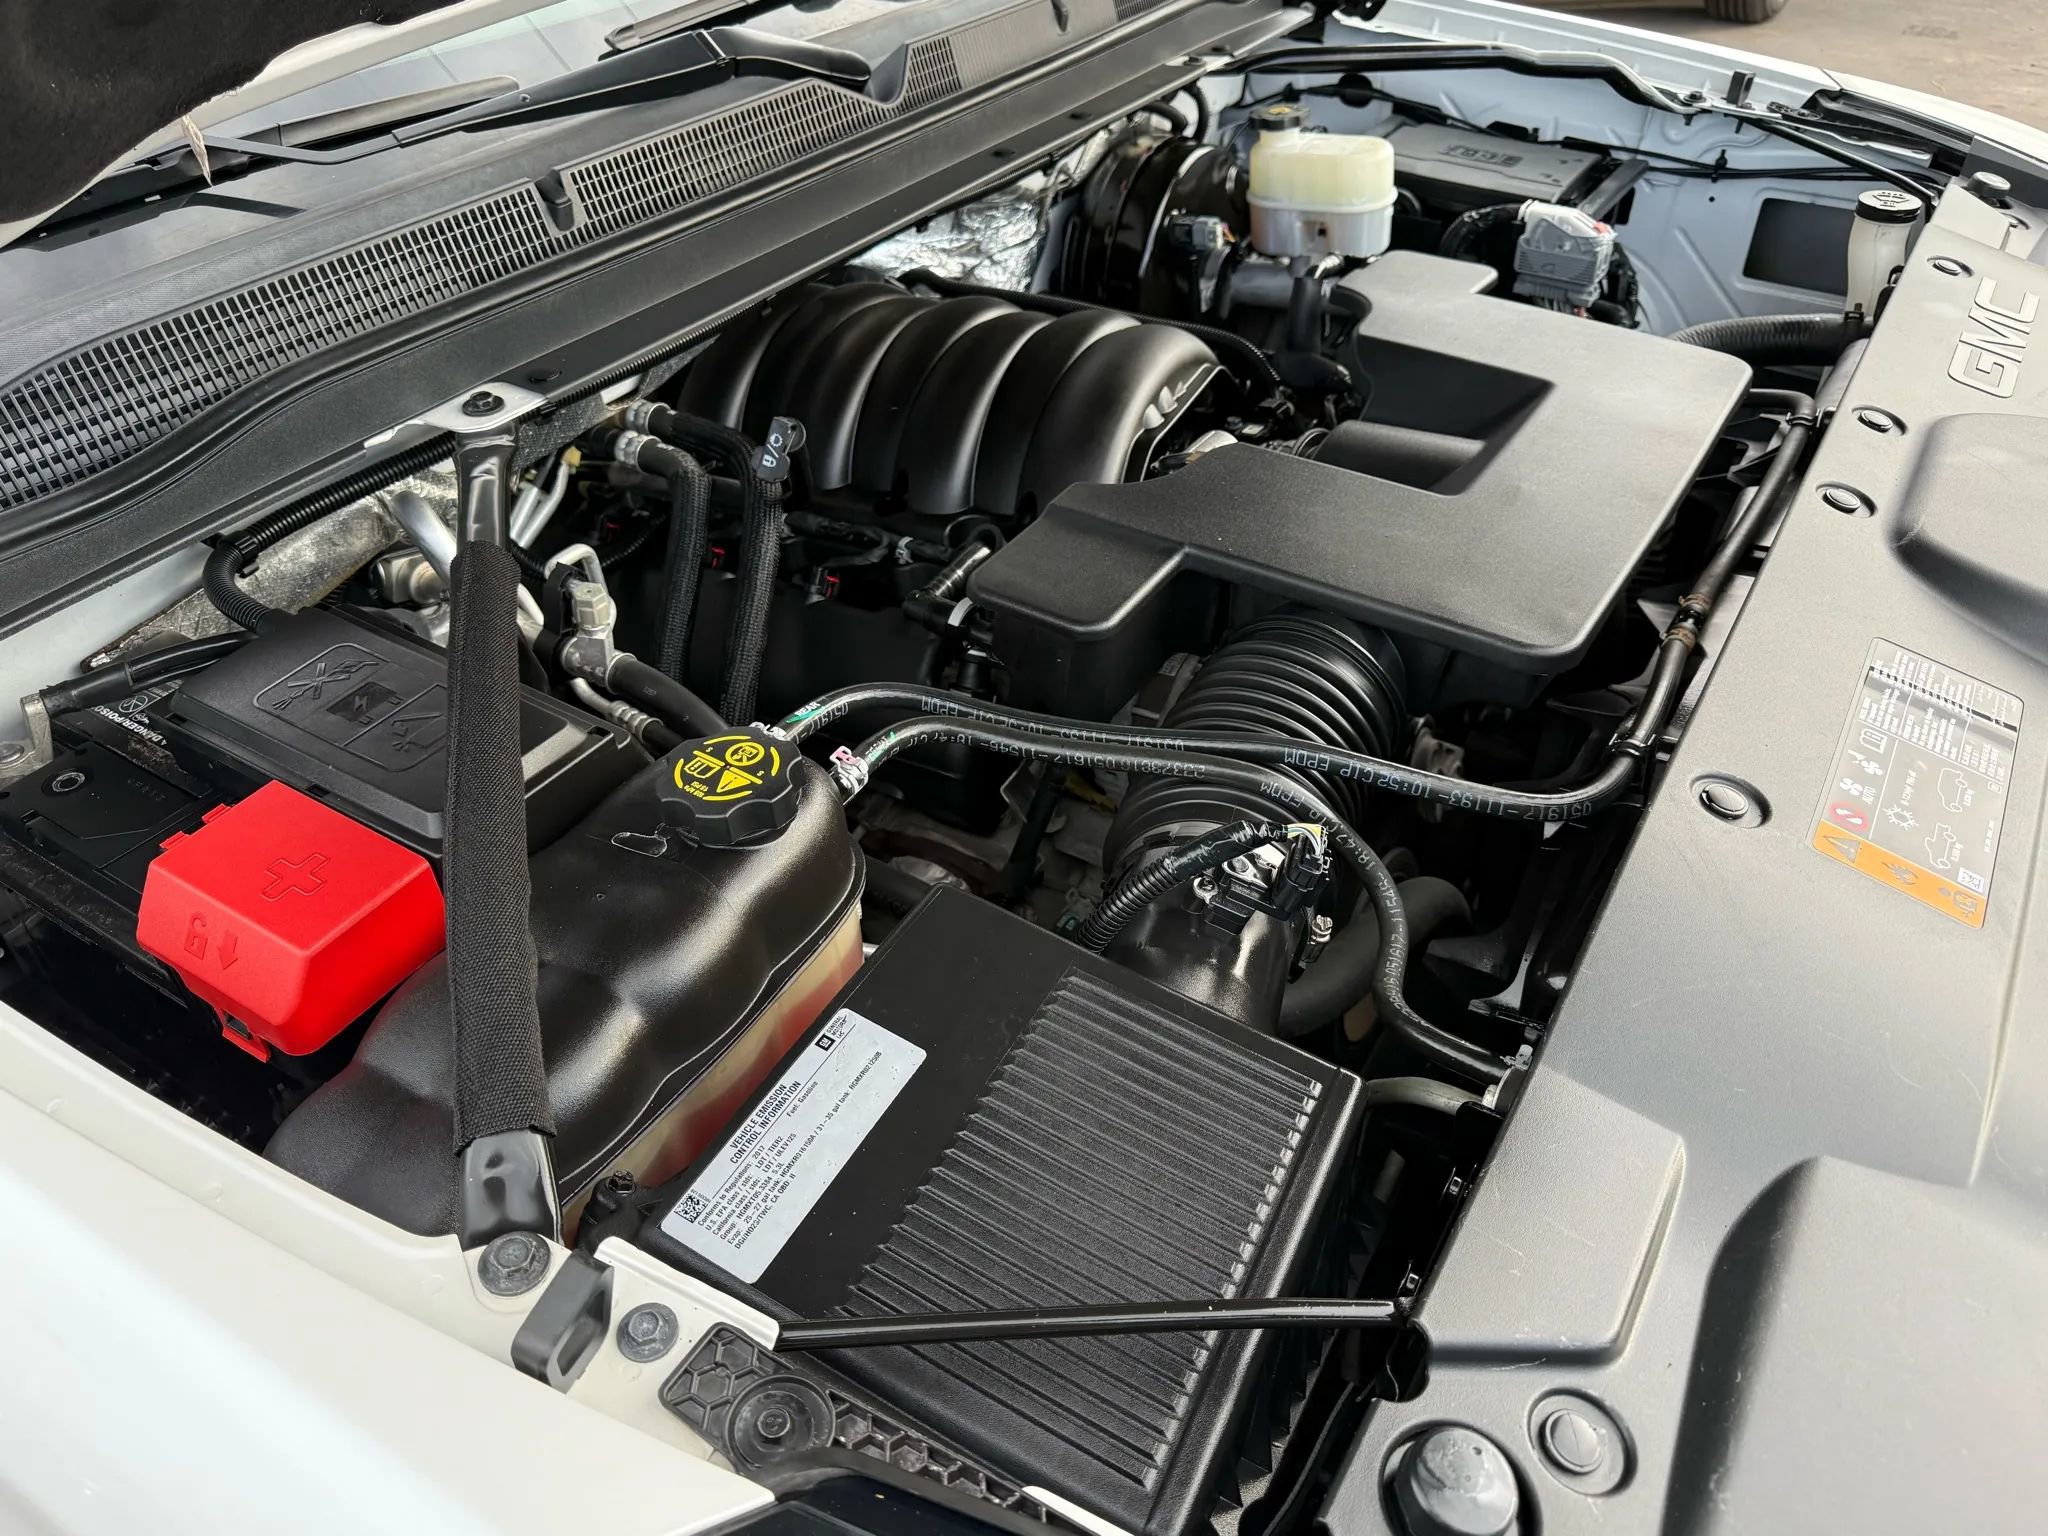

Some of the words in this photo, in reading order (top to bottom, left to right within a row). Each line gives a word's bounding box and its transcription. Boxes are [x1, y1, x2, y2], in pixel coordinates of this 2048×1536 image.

[1947, 276, 2040, 398] GMC
[91, 705, 163, 742] DANGER/POISO
[795, 701, 821, 716] REAR
[921, 696, 958, 717] EPDM
[1284, 747, 1331, 771] EPDM
[1260, 782, 1305, 808] EPDM
[818, 1036, 830, 1047] GM
[825, 1014, 843, 1033] GENERAL
[796, 1079, 818, 1103] Gasoline
[729, 1118, 758, 1149] VEHICLE
[755, 1083, 787, 1118] EMISSION
[729, 1128, 762, 1164] CONTROL
[758, 1080, 801, 1129] INFORMATION
[759, 1191, 771, 1203] gal
[830, 1102, 841, 1113] gal
[696, 1199, 721, 1227] Conforms
[718, 1192, 727, 1200] to
[723, 1160, 754, 1194] Regulations:
[751, 1144, 766, 1159] 2017
[715, 1204, 728, 1218] EPA
[724, 1190, 740, 1205] class
[754, 1156, 767, 1168] LDT
[767, 1135, 784, 1152] TIER2
[769, 1193, 780, 1203] CA
[776, 1178, 792, 1194] OBD:
[711, 1208, 736, 1235] California
[733, 1192, 749, 1209] class
[761, 1160, 774, 1173] LDT
[719, 1220, 738, 1240] Group:
[770, 1160, 784, 1175] 5.3L
